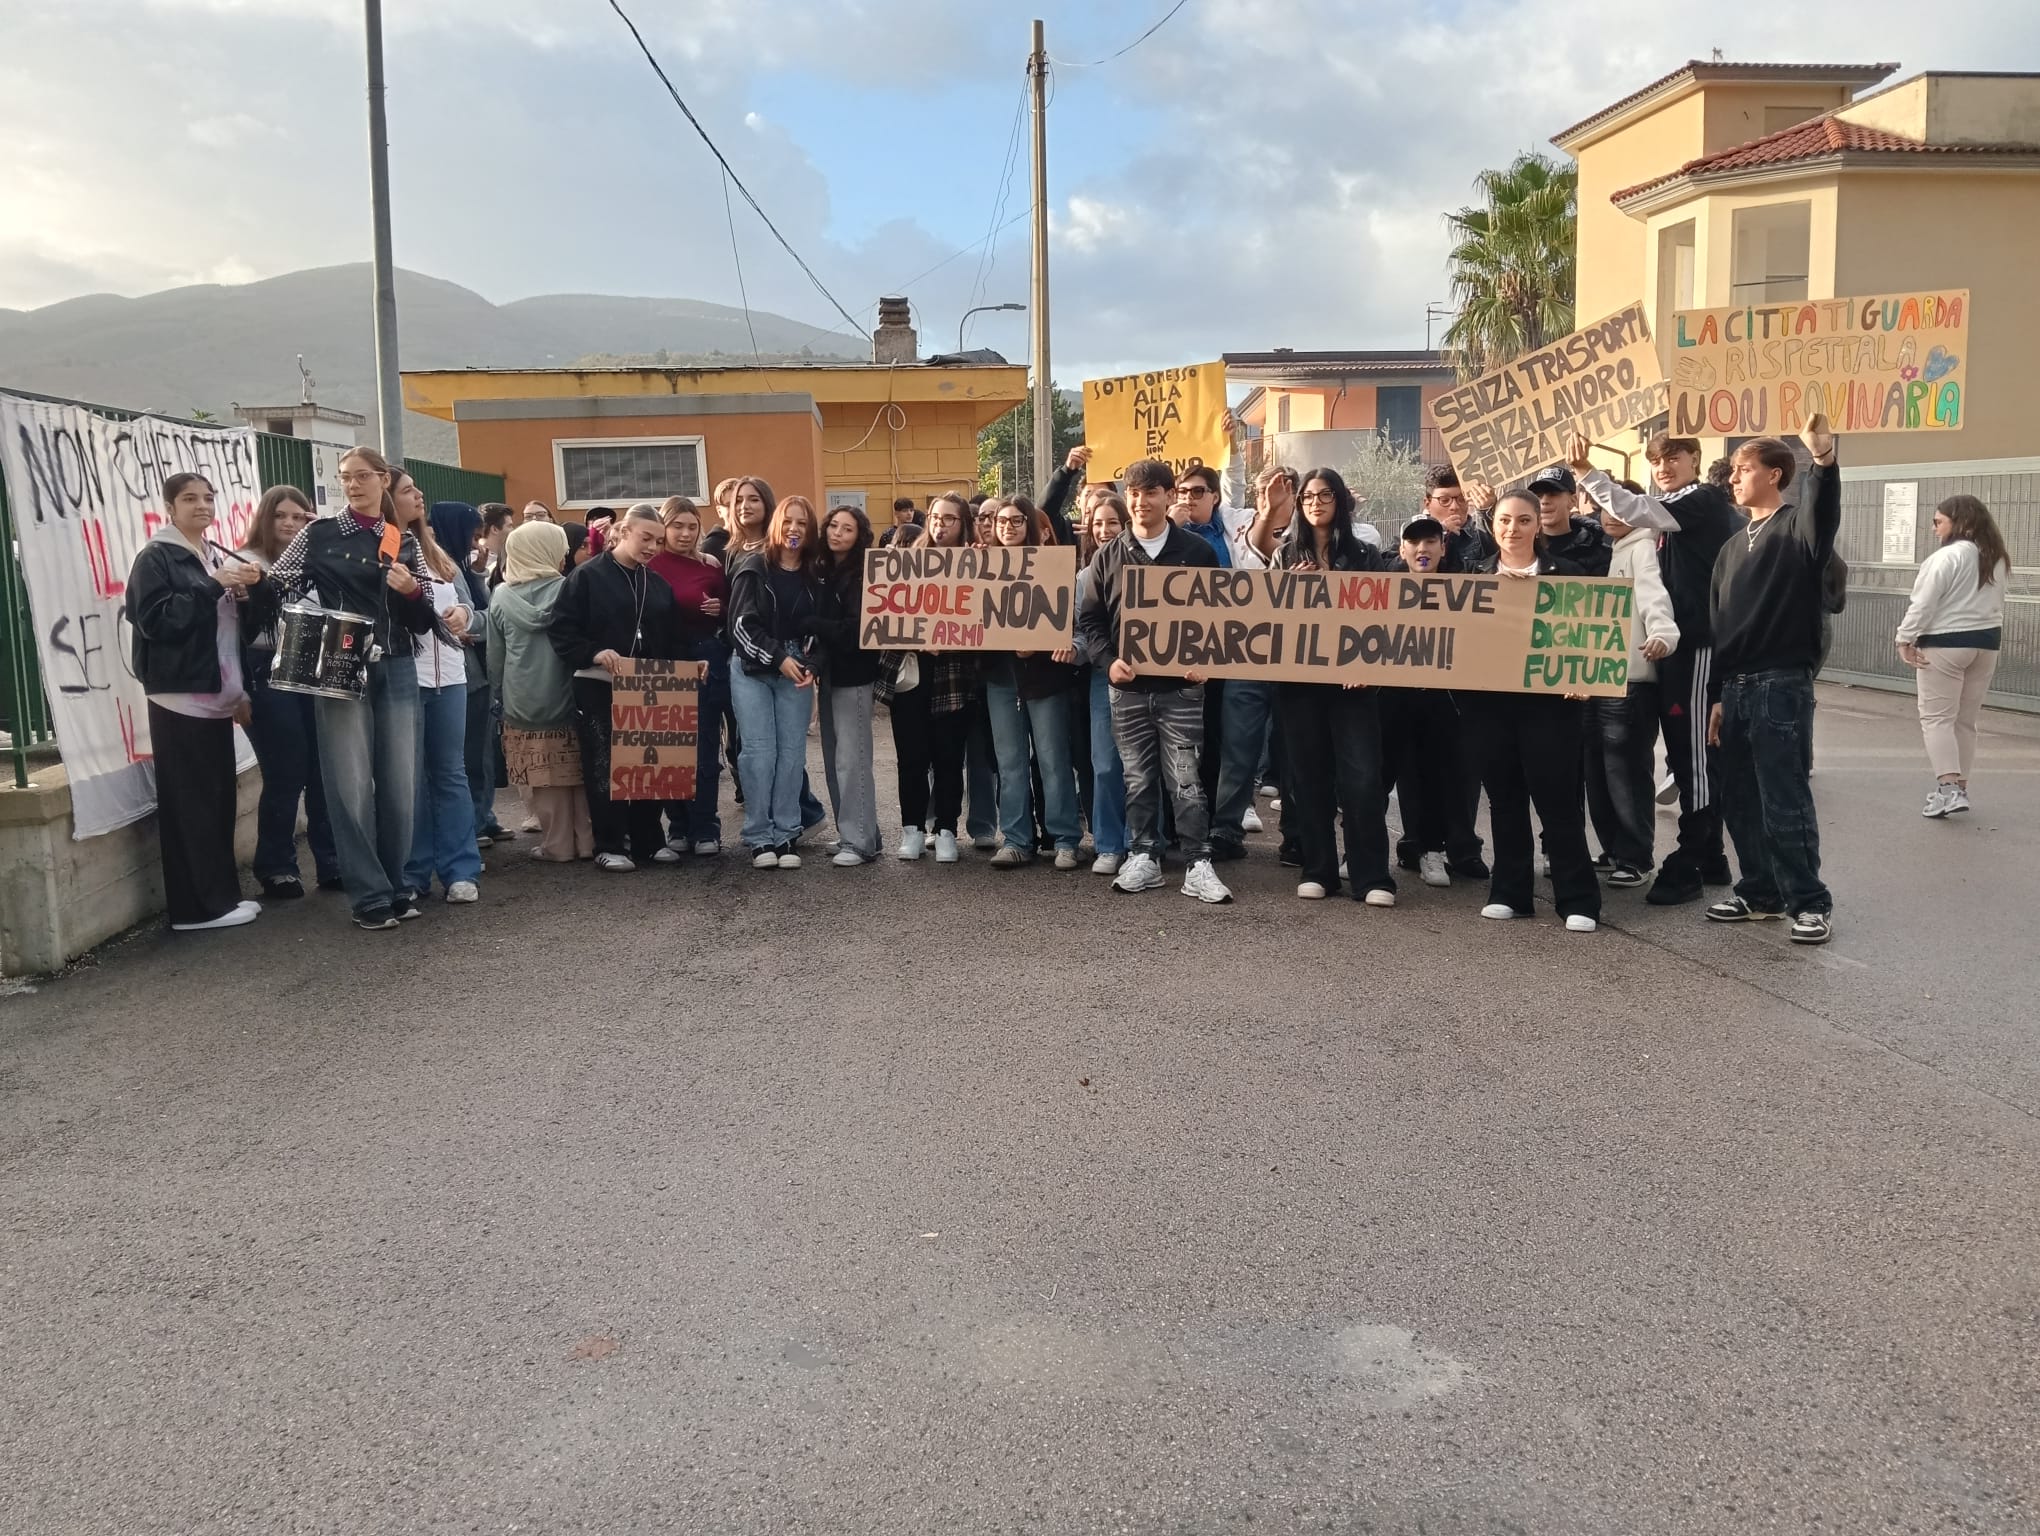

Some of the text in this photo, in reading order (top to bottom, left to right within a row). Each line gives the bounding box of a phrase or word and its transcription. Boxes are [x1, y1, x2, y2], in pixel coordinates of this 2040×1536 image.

[1678, 296, 1962, 347] LA CITTÀ TI GUARDA
[1434, 307, 1651, 433] SENZA TRASPORTI,
[1725, 335, 1917, 385] RISPETTALA
[1094, 367, 1197, 400] SOTTOMESSO
[1134, 384, 1182, 407] ALLA
[1134, 402, 1181, 430] MIA
[1676, 379, 1960, 435] NON ROVINARLA
[1146, 430, 1169, 447] EX
[1146, 445, 1163, 456] NON
[1449, 405, 1538, 471] SENZA
[19, 423, 105, 523] NON
[1462, 432, 1557, 488] SENZA
[82, 518, 125, 598] IL
[867, 547, 1038, 584] FONDI ALLE
[866, 582, 1069, 631] SCUOLE NON
[1125, 569, 1499, 614] IL CARO VITA NON DEVE
[1534, 581, 1632, 618] DIRITTI
[862, 616, 984, 647] ALLE ARMI
[1122, 619, 1283, 666] RUBARCI
[1295, 624, 1329, 666] IL
[1530, 619, 1626, 651] DIGNITÀ
[635, 659, 675, 675] NON
[1523, 654, 1628, 688] FUTURO
[643, 691, 658, 706] A
[612, 704, 698, 731] VIVERE
[643, 746, 659, 764] A
